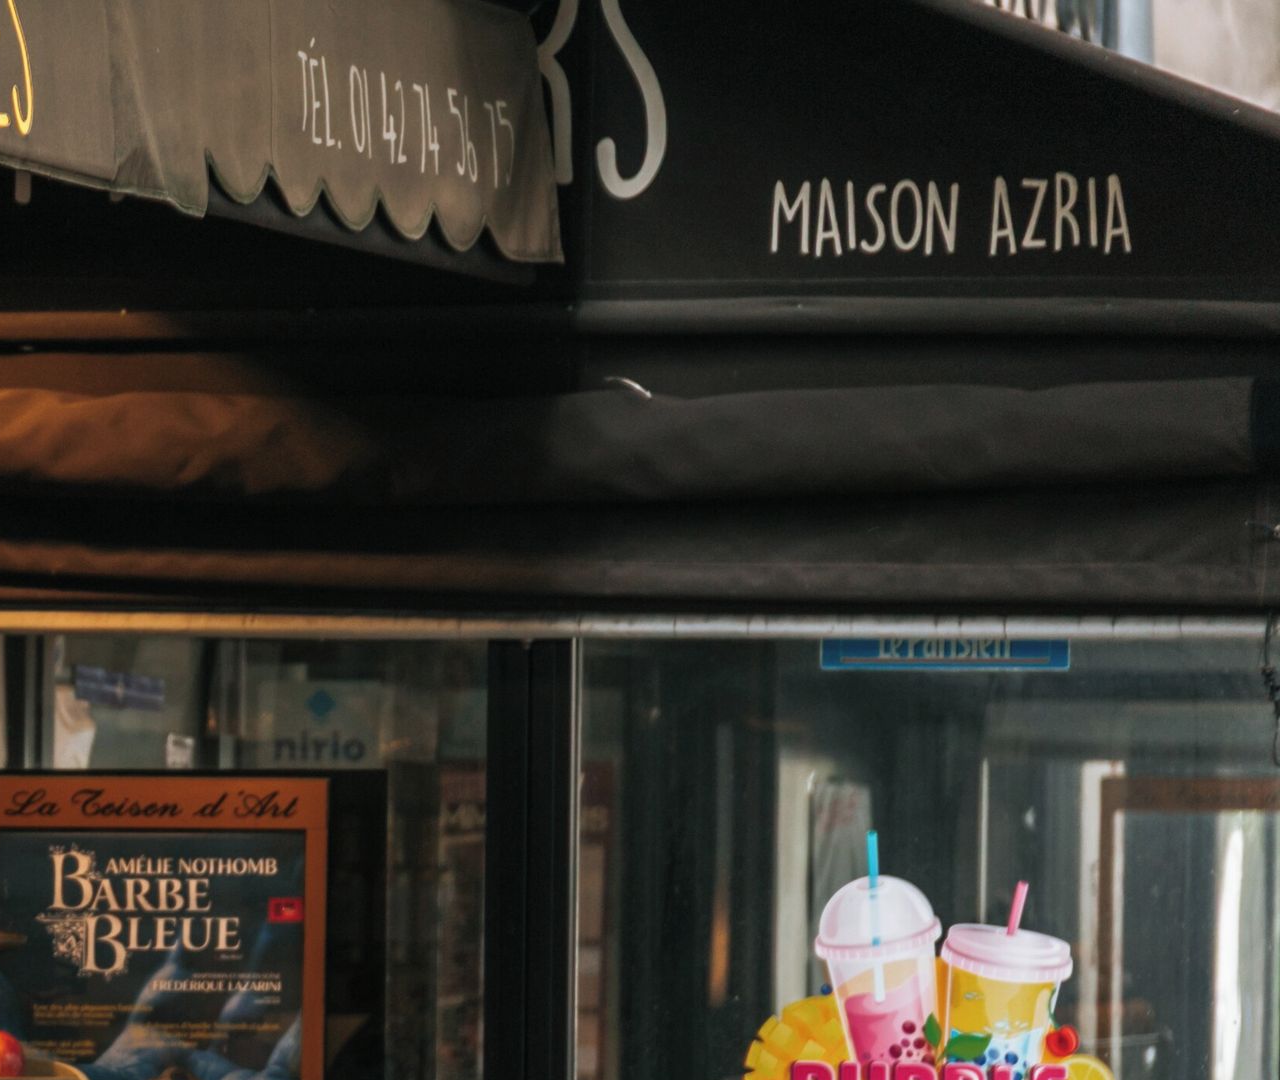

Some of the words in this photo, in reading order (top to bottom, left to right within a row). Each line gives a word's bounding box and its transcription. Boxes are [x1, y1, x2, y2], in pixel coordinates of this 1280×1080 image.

[297, 37, 342, 150] TÉL.
[349, 65, 372, 159] 01
[381, 72, 407, 165] 42
[413, 83, 440, 175] 74
[447, 88, 478, 184] 56
[484, 100, 515, 189] 75
[769, 178, 959, 257] MAISON
[989, 172, 1132, 256] AZRIA
[4, 788, 60, 817] La
[71, 788, 181, 818] Toison
[49, 850, 213, 912] BARBE
[105, 854, 173, 875] AMÉLIE
[178, 857, 278, 876] NOTHOMB
[83, 915, 242, 974] BLEUE
[228, 980, 282, 994] LAZARINI
